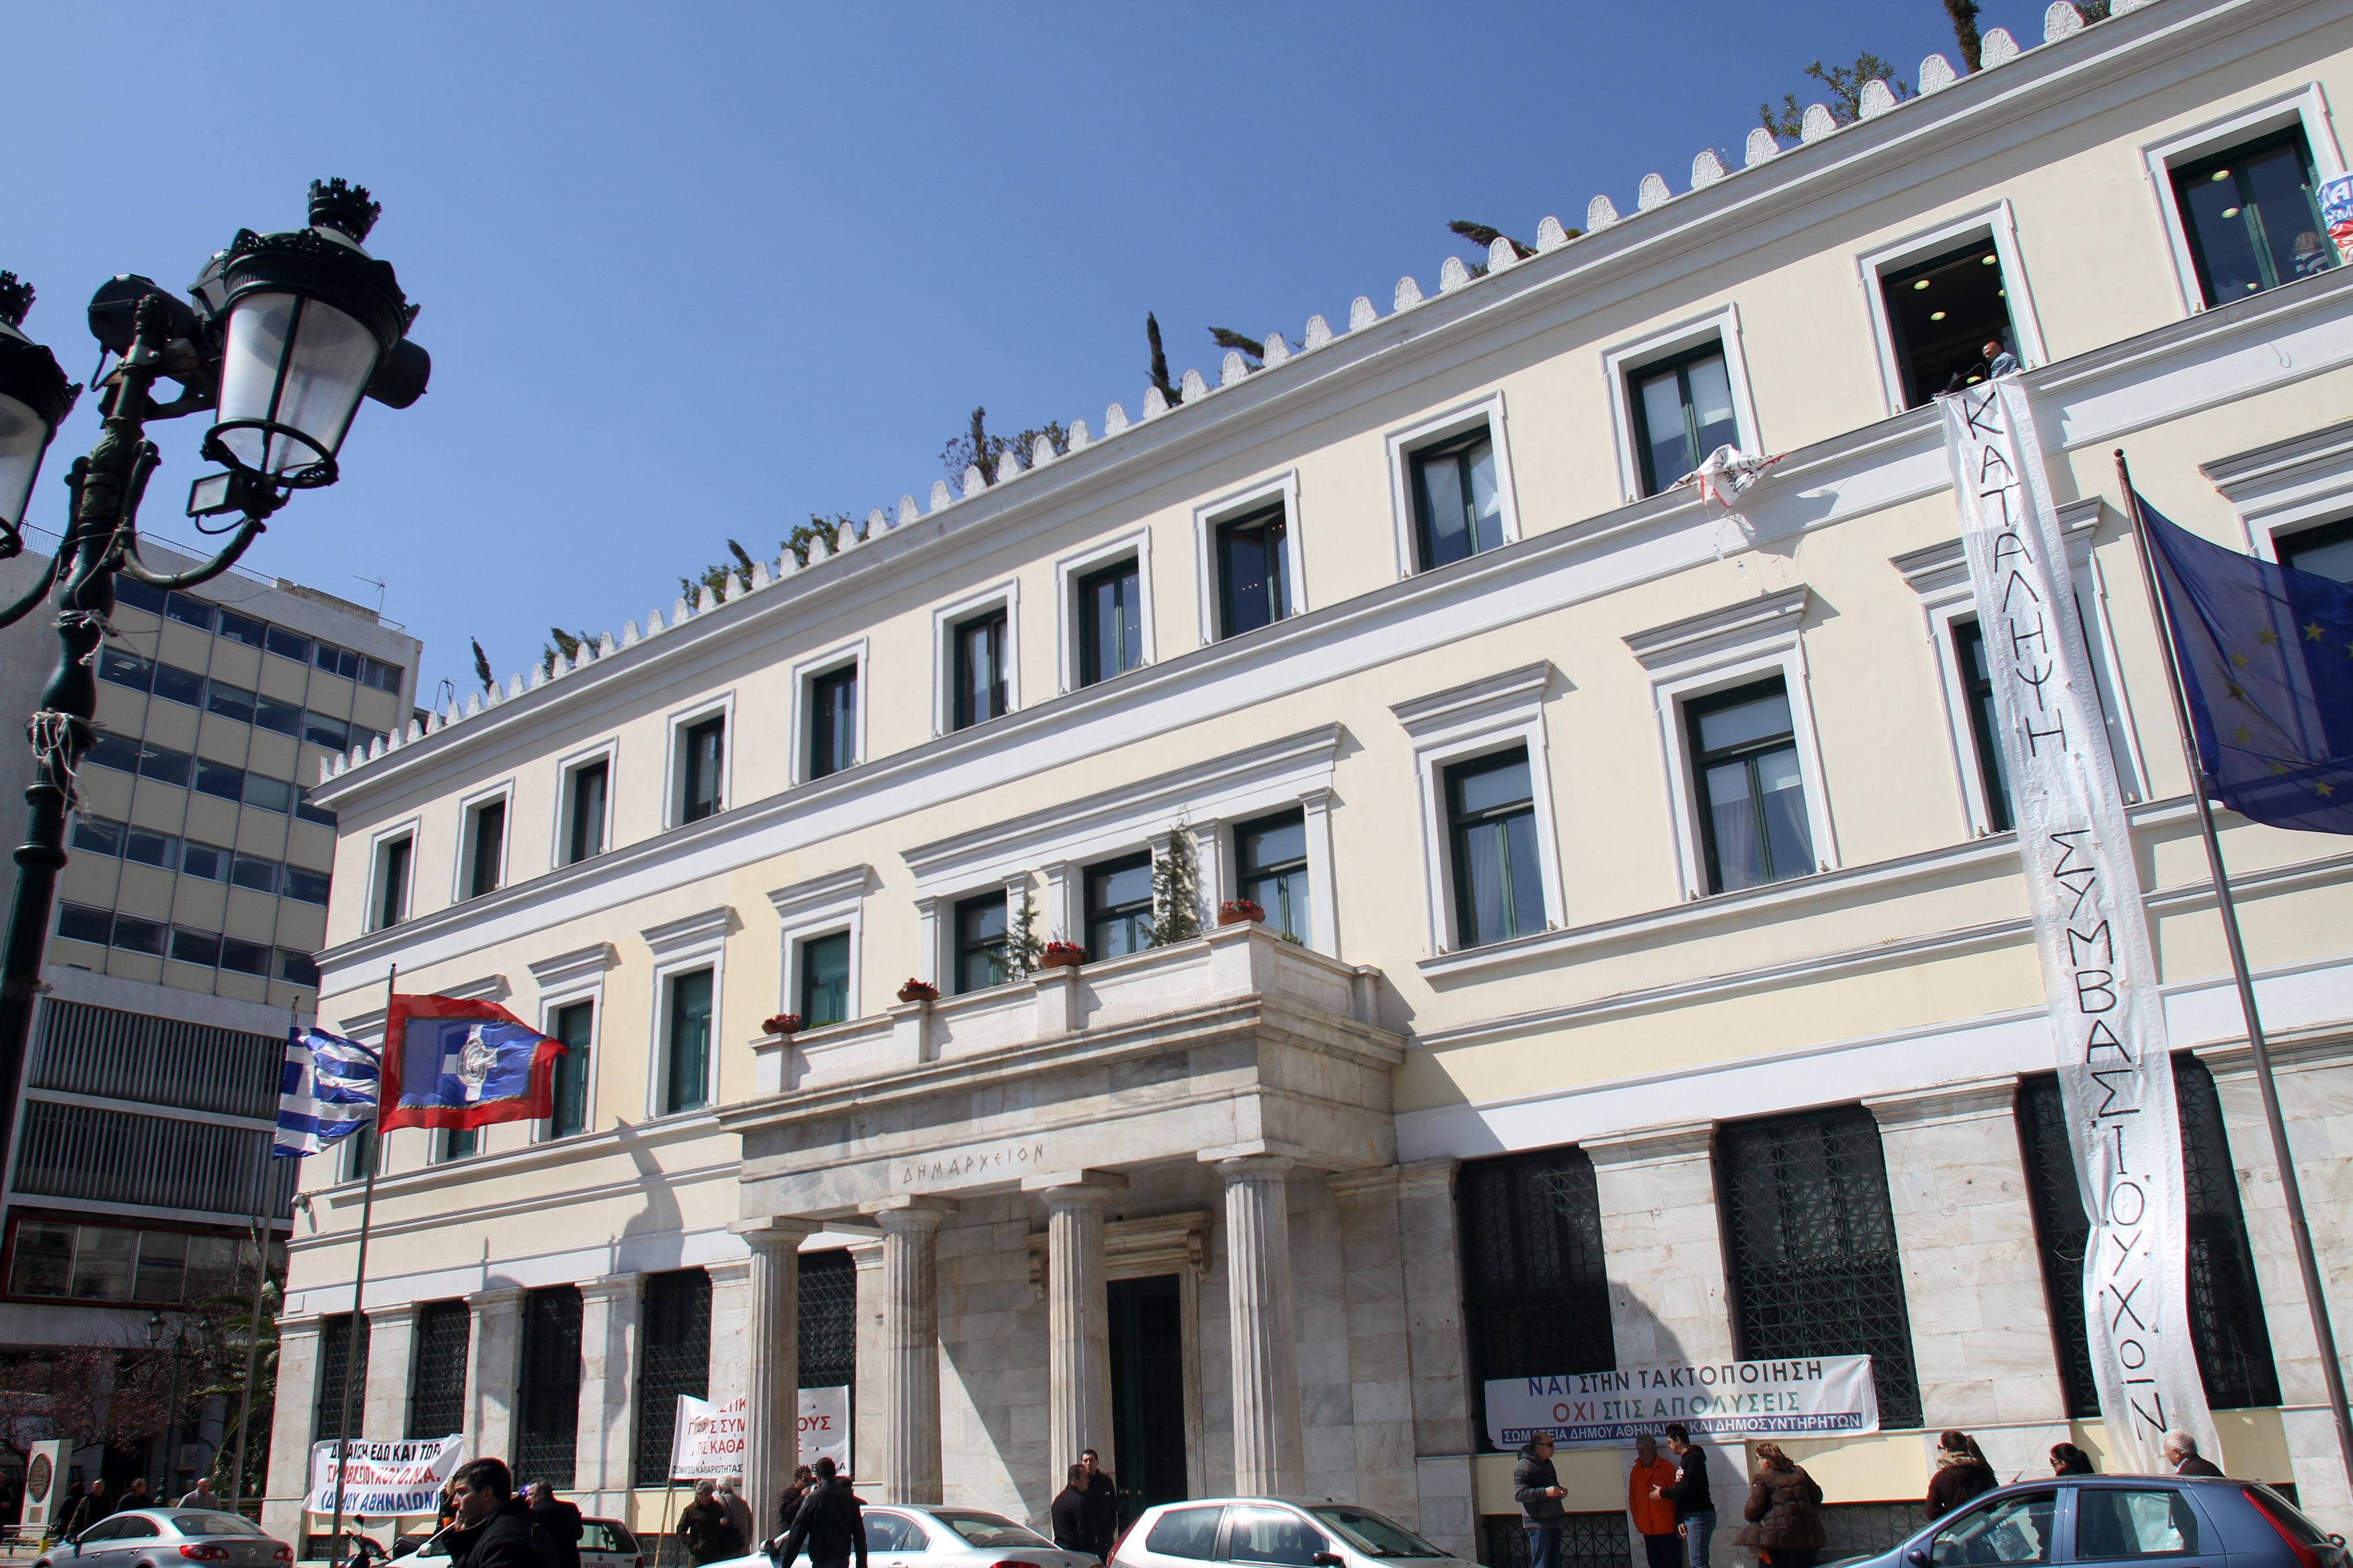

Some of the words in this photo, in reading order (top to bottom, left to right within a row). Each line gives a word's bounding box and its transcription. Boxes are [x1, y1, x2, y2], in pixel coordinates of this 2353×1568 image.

[1962, 391, 2067, 757] ΚΑΤΑΛΗΨΗ
[903, 1144, 1043, 1185] ΔΗΜΑΡΧΕΙΟΝ
[1528, 1375, 1572, 1396] ΝΑΙ
[1580, 1371, 1630, 1393] ΣΤΗΝ
[1638, 1360, 1823, 1389] ΤΑΚΤΟΠΟΙΗΣΗ
[1552, 1401, 1596, 1423] ΟΧΙ
[1603, 1399, 1644, 1420] ΣΤΙΣ
[1652, 1391, 1800, 1417] ΑΠΟΛΥΣΕΙΣ
[1570, 1426, 1613, 1439] ΔΗΜΟΥ
[1689, 1419, 1712, 1433] ΚΑΙ
[1716, 1414, 1861, 1432] ΔΗΜΟΣΥΝΤΗΡΗΤΩΝ
[370, 1444, 390, 1460] ΕΔΩ
[393, 1444, 417, 1461] ΚΑΙ
[696, 1464, 744, 1475] ΚΑΘΑΡΙΟΤΗΤΑΣ
[359, 1489, 438, 1512] ΑΘΗΝΑΙΩΝ)
